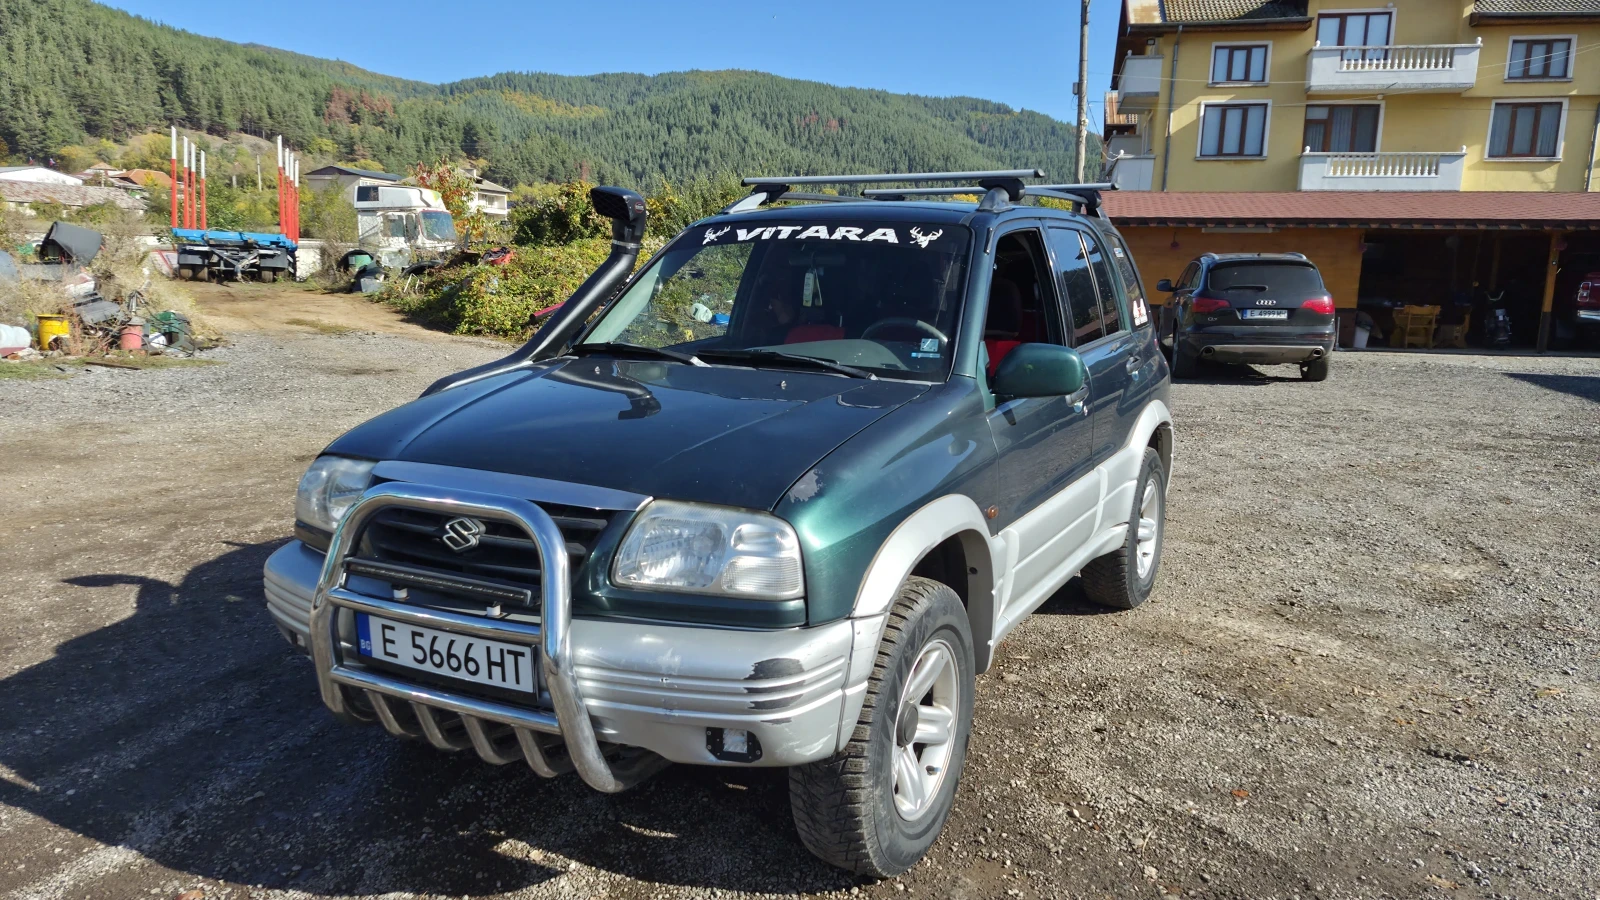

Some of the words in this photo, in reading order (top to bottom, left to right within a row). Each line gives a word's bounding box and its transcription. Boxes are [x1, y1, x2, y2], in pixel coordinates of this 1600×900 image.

[736, 225, 899, 244] VITARA
[360, 638, 371, 651] BG
[381, 623, 398, 658] E
[411, 630, 480, 676] 5666
[486, 645, 525, 685] HT
